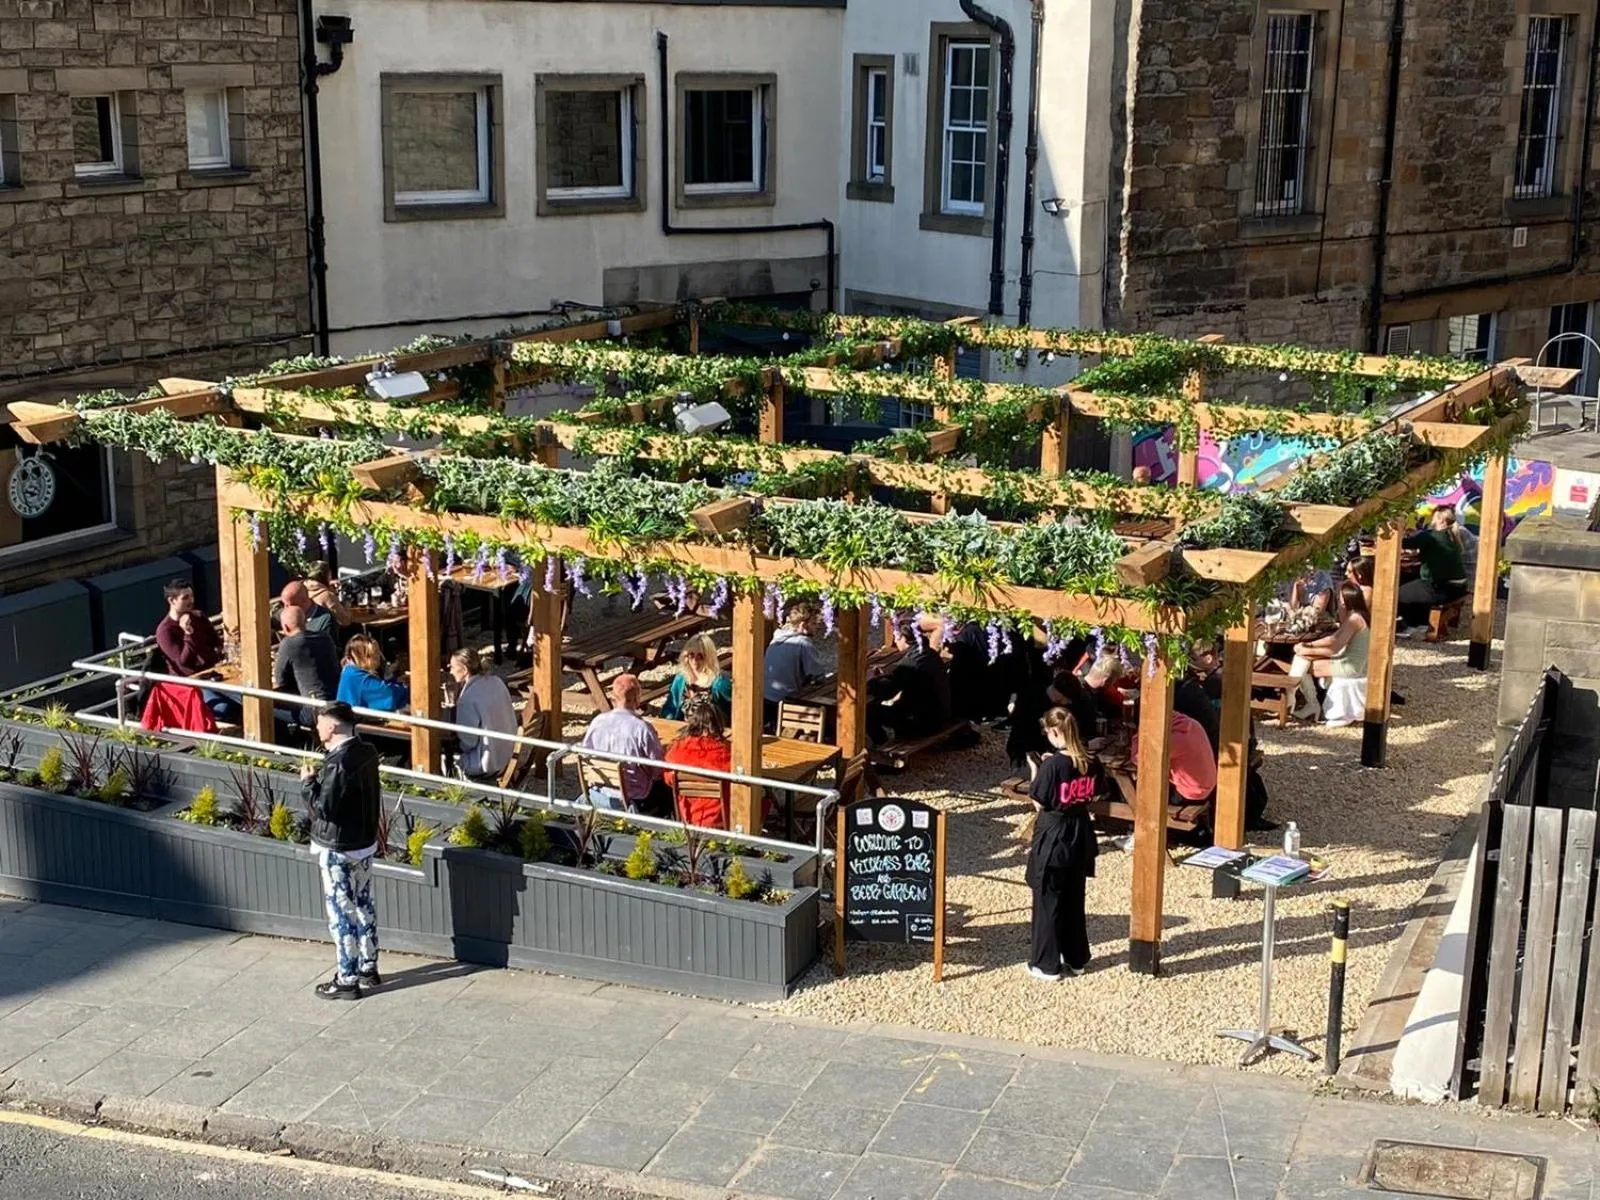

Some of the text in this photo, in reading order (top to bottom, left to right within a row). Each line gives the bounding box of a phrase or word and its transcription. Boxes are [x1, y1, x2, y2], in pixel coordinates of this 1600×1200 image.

[854, 834, 924, 853] WELCOME TO
[849, 853, 931, 874] KICKASS BAR
[850, 882, 927, 903] BEER GARDEN
